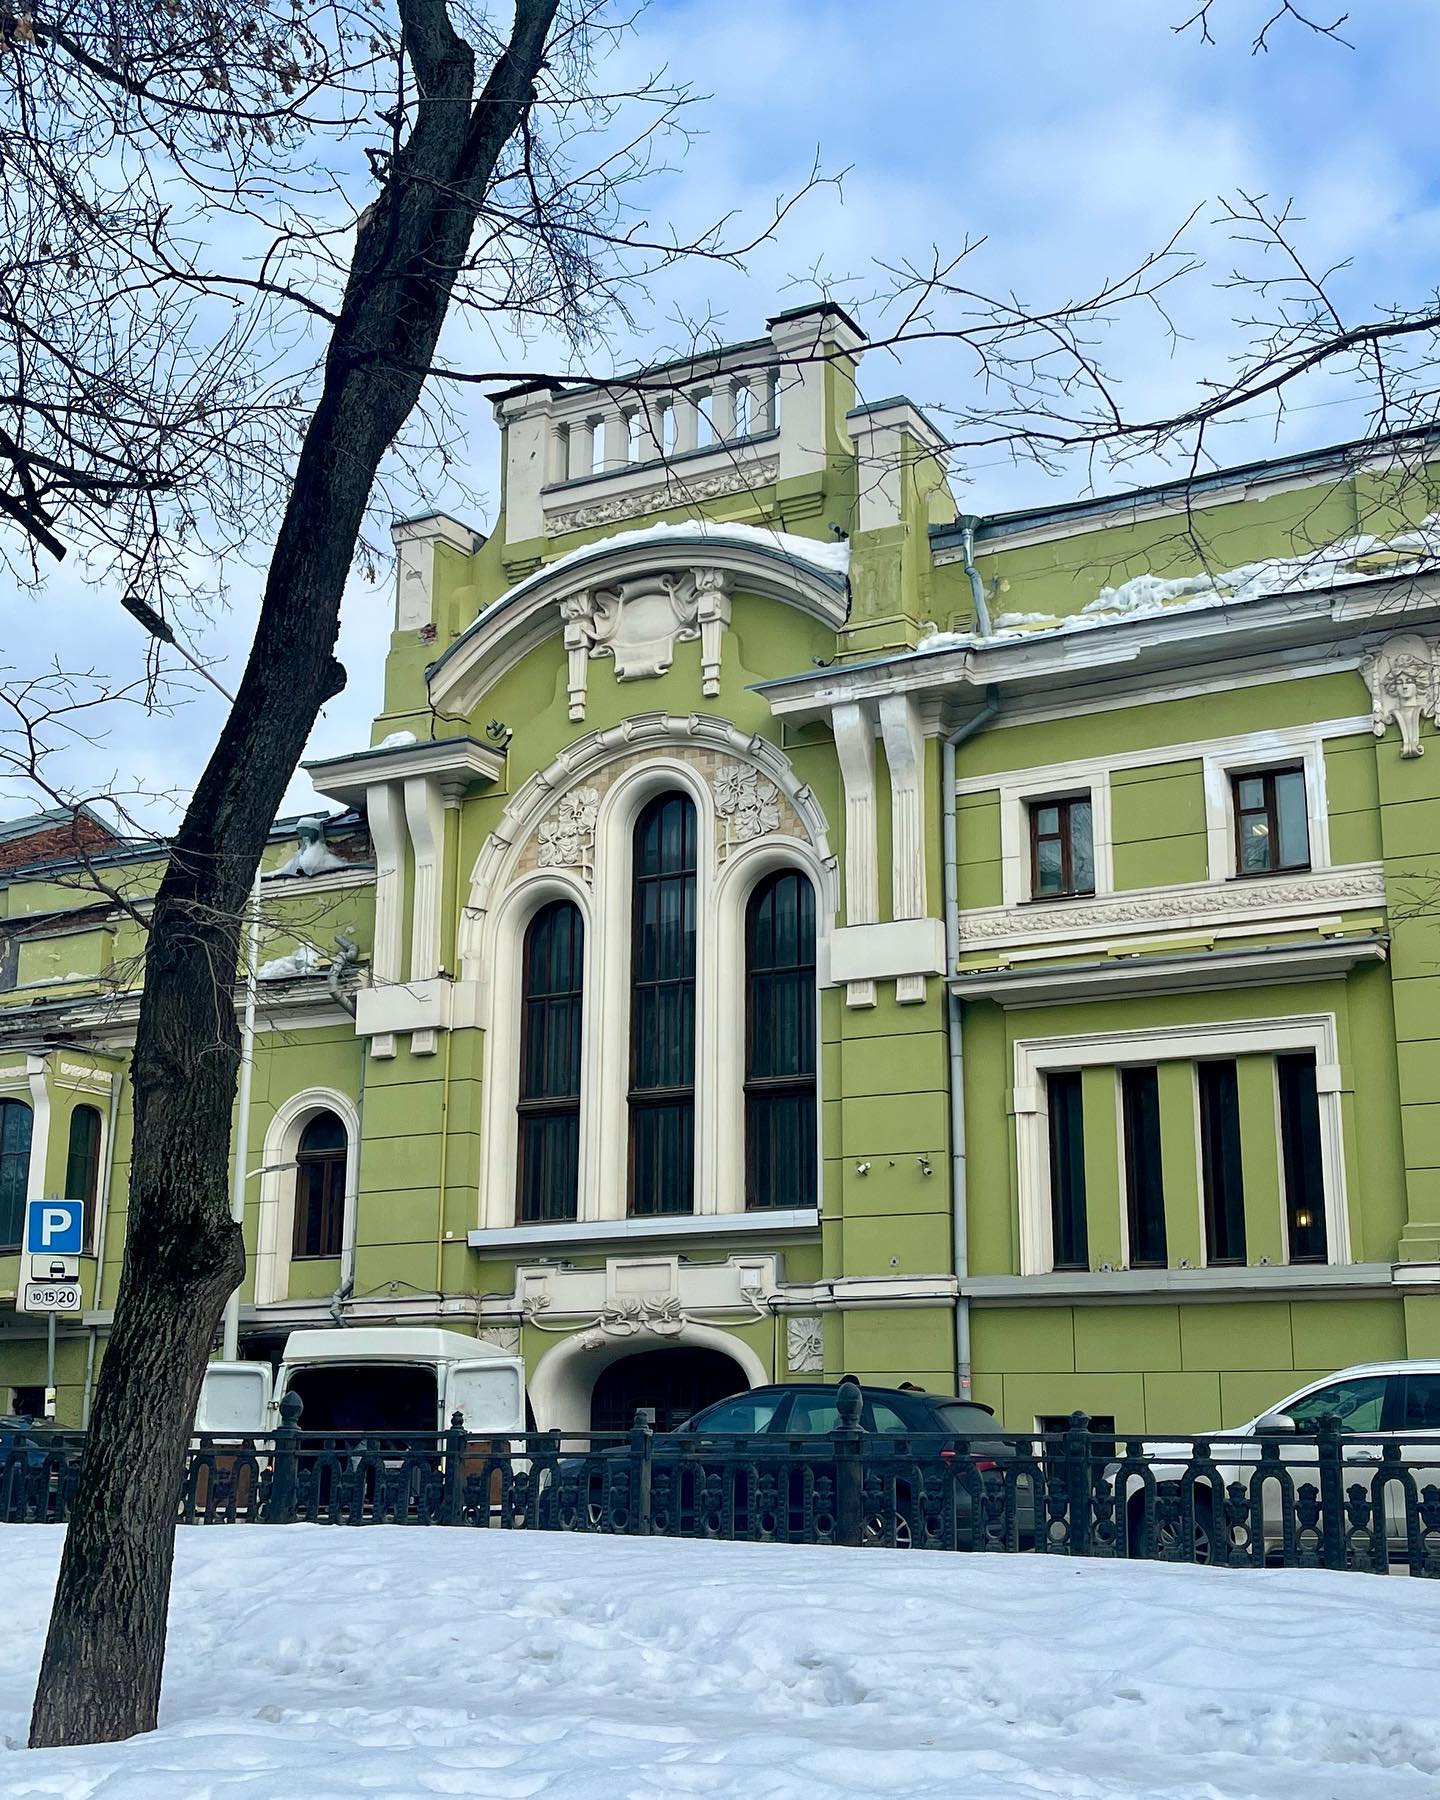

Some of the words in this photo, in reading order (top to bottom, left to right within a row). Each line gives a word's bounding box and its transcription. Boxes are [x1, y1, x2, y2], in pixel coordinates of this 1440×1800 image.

[42, 1208, 72, 1246] P
[44, 1292, 54, 1301] 15
[58, 1292, 74, 1302] 20
